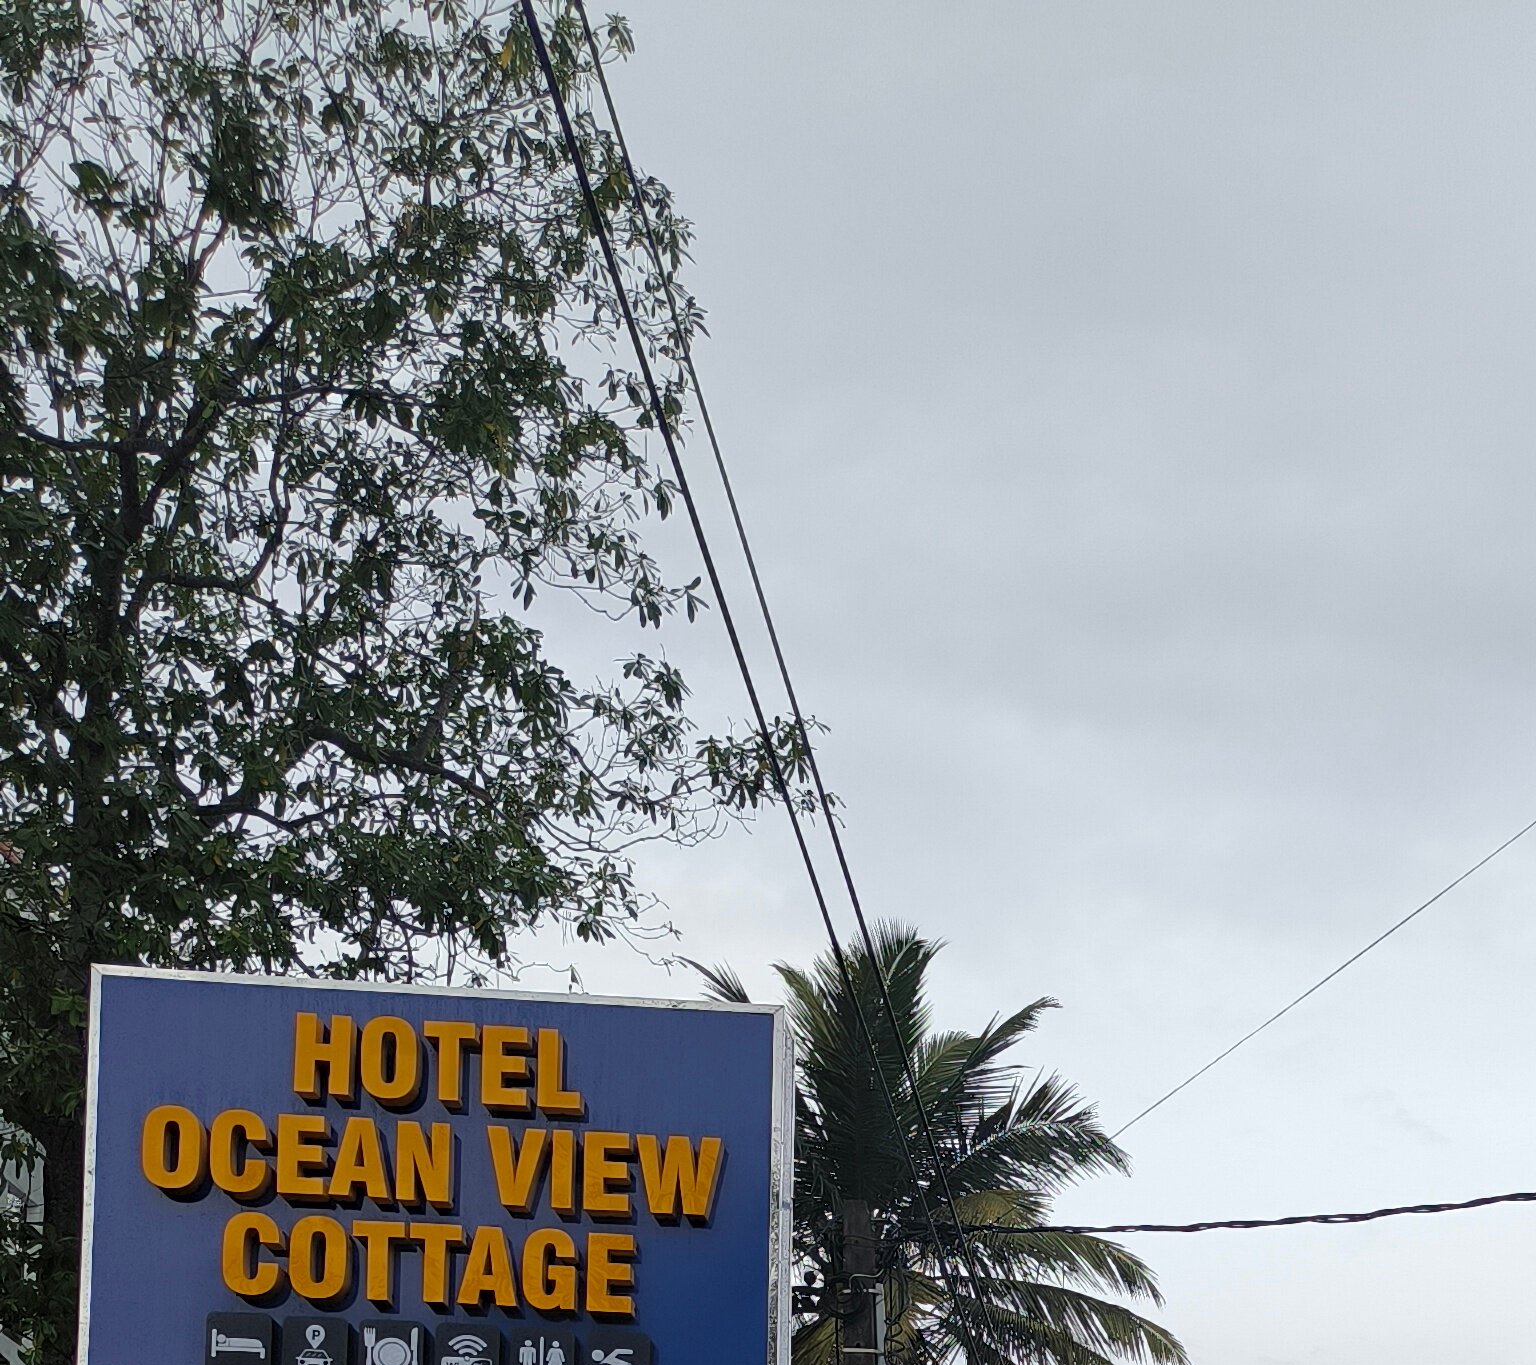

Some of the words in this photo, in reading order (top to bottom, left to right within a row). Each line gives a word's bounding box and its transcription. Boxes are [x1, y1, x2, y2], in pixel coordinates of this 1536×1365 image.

[292, 1011, 584, 1114] HOTEL
[140, 1104, 456, 1210] OCEAN
[487, 1124, 725, 1219] VIEW
[221, 1211, 638, 1316] COTTAGE
[312, 1329, 321, 1341] P
